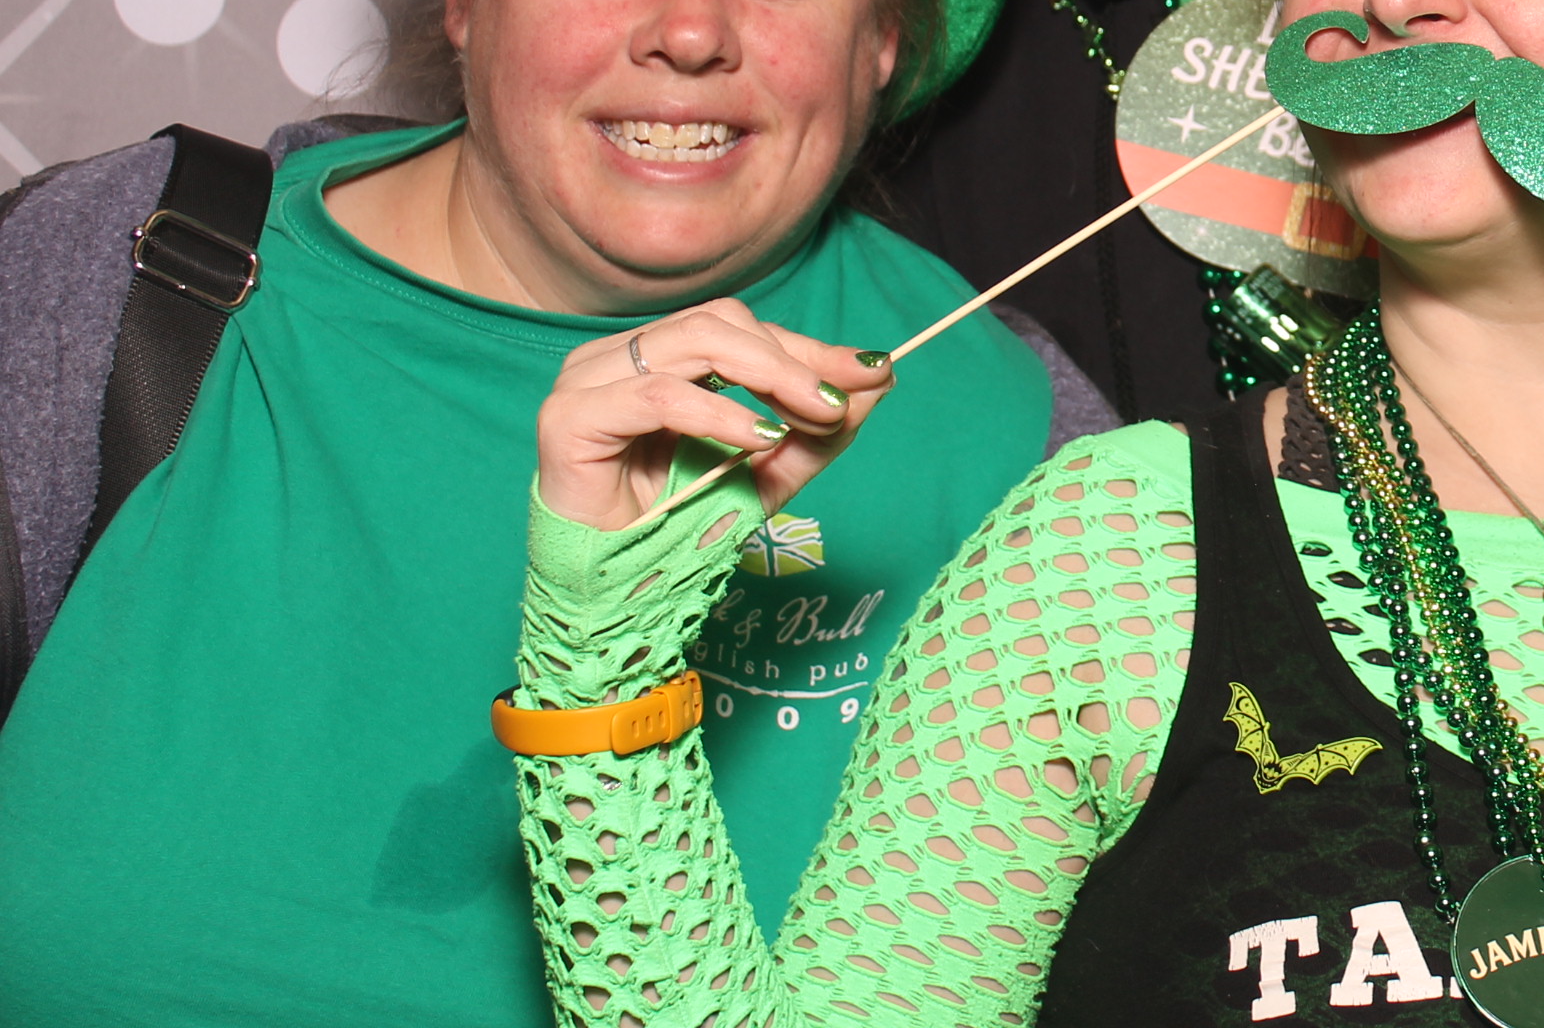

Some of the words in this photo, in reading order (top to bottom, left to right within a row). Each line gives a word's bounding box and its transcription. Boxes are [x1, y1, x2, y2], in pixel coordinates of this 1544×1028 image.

[1171, 37, 1273, 101] SHE
[1259, 109, 1316, 167] BE
[776, 589, 886, 646] Bull
[694, 641, 780, 679] glish
[809, 652, 869, 686] pub
[715, 692, 860, 731] 009
[1228, 900, 1464, 1022] TA
